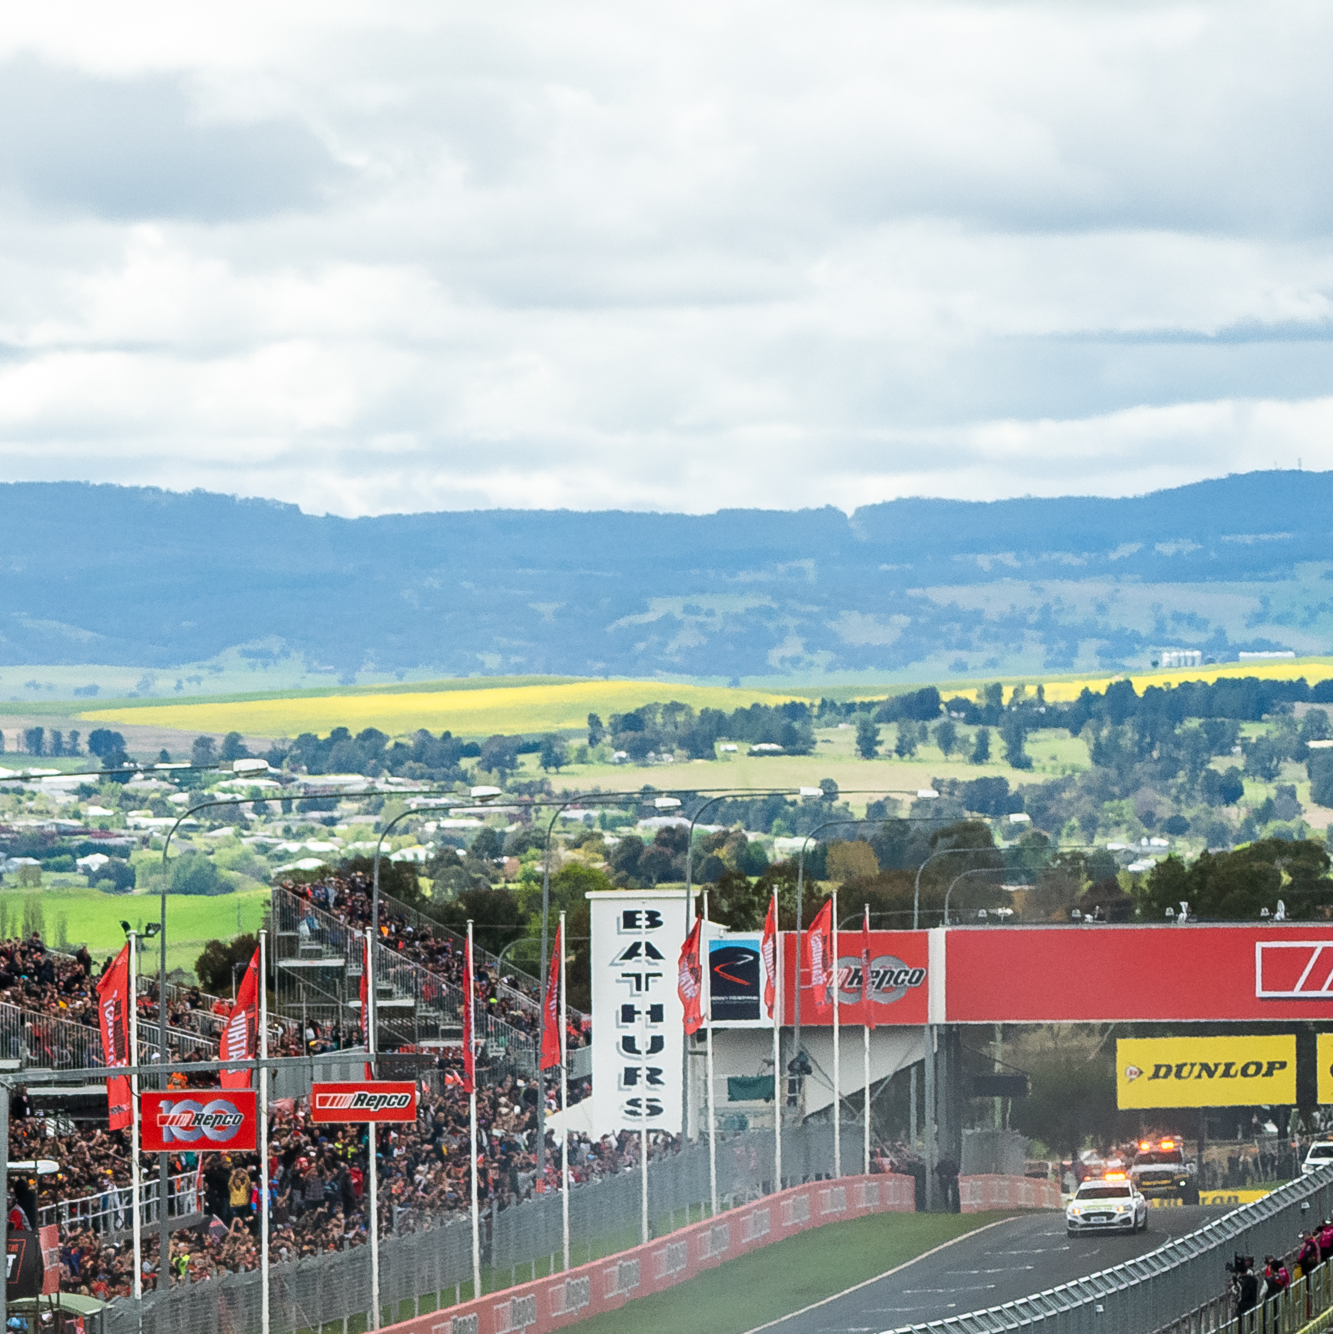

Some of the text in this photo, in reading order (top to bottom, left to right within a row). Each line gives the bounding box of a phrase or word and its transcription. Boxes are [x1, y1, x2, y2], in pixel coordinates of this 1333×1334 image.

[1148, 1061, 1287, 1080] DUNLOP
[353, 1093, 410, 1109] Repco
[192, 1113, 244, 1128] Repco
